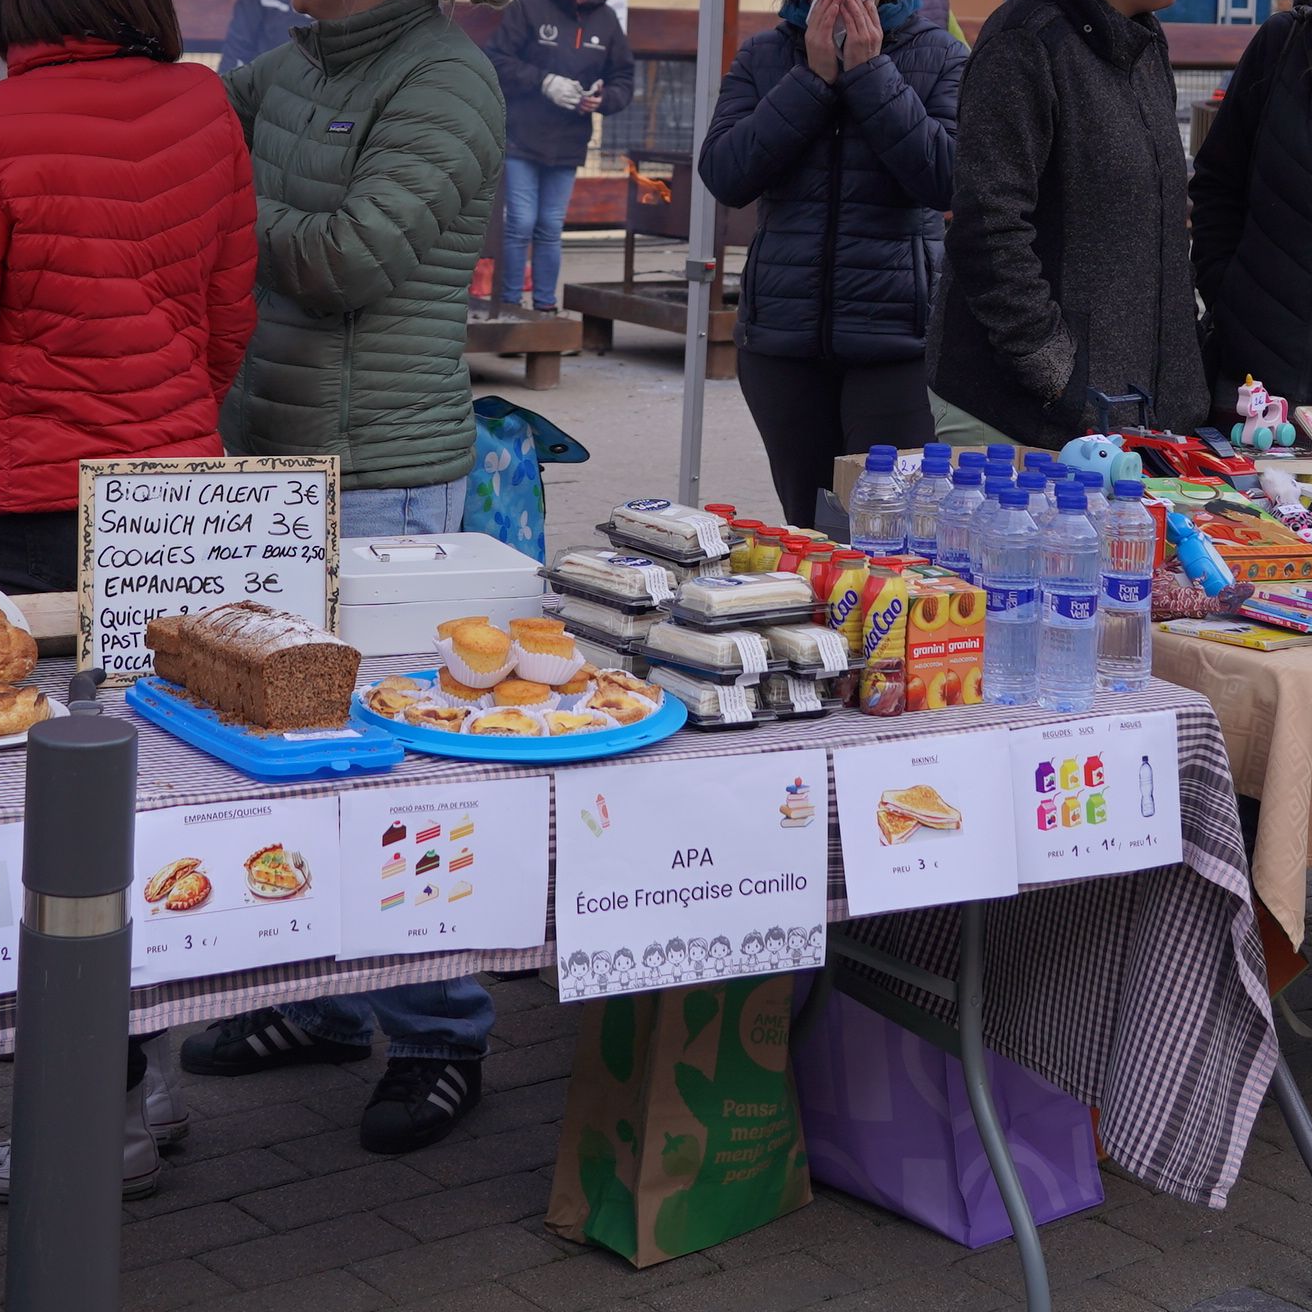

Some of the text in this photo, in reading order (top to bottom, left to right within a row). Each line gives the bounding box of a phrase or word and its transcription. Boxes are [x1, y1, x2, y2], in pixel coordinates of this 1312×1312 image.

[199, 484, 278, 505] CALENT
[207, 545, 257, 561] MOLT
[262, 545, 297, 560] BONS
[301, 546, 326, 563] 2,50
[105, 574, 225, 597] EMPANADES
[1119, 584, 1139, 593] Font
[1070, 601, 1090, 610] Font
[1069, 609, 1090, 619] Vella
[913, 643, 945, 659] granini
[948, 637, 980, 653] granini
[671, 847, 714, 870] APA
[1071, 845, 1079, 857] 1
[892, 858, 926, 874] PREU 3
[576, 872, 807, 915] École Française Canillo
[146, 944, 168, 955] PREU
[184, 934, 193, 950] 3
[258, 928, 279, 938] PREU
[289, 919, 299, 932] 2
[407, 928, 428, 937] PREU
[439, 922, 447, 934] 2
[0, 946, 12, 961] 2
[721, 1098, 778, 1118] Pensa
